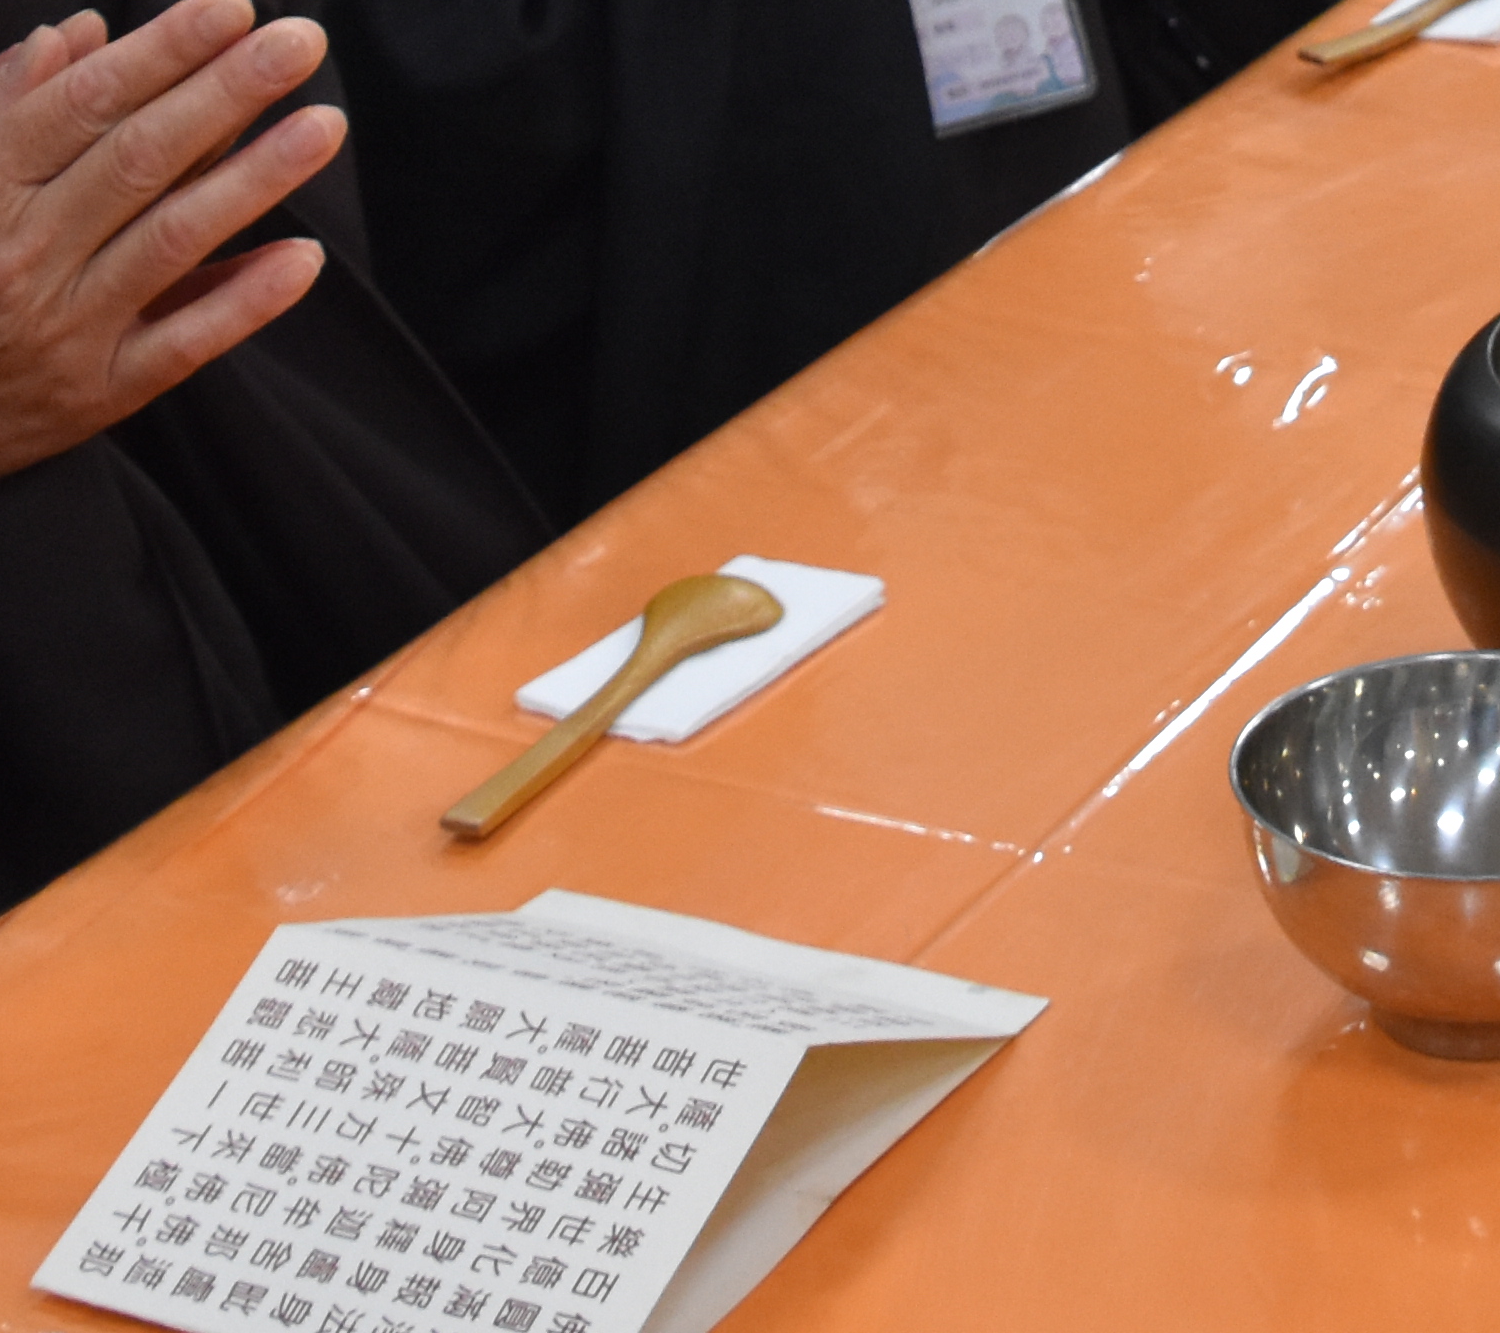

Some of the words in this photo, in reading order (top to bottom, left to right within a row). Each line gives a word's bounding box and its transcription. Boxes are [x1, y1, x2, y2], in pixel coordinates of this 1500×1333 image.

[245, 995, 725, 1131] 薩。大行普賢菩薩。大悲觀
[275, 958, 748, 1090] 世音菩薩。大願地藏王菩
[208, 1078, 671, 1214] 生彌勒尊佛。十方三世一
[220, 1037, 697, 1175] 切諸佛。大智文殊師利菩
[133, 1158, 621, 1303] 百億化身釋迦牟尼佛。極
[171, 1123, 646, 1258] 樂世界阿彌陀佛。當來下
